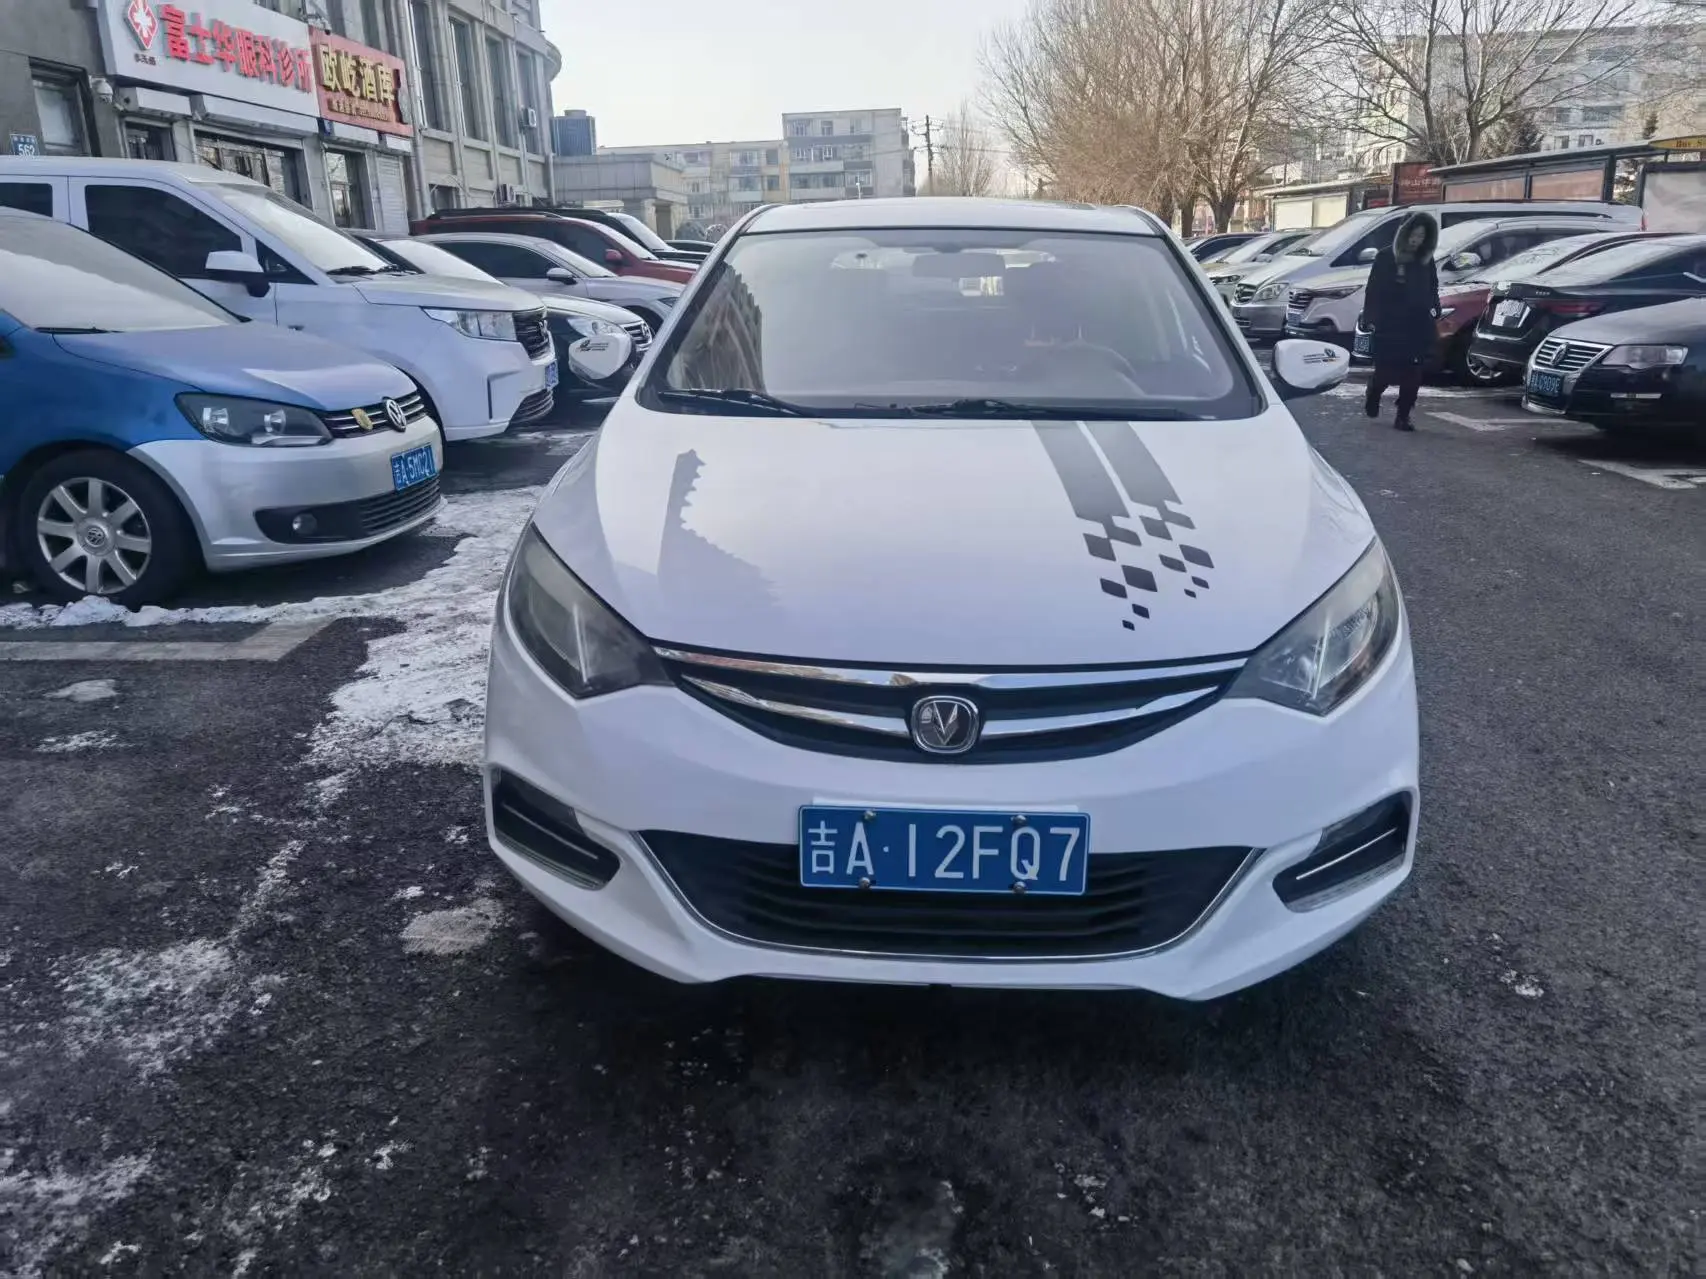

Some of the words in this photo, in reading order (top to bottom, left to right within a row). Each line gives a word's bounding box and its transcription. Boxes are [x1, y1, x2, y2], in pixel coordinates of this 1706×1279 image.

[160, 4, 312, 93] 富士华眼科诊所
[807, 820, 1081, 882] 吉A·12FQ7
